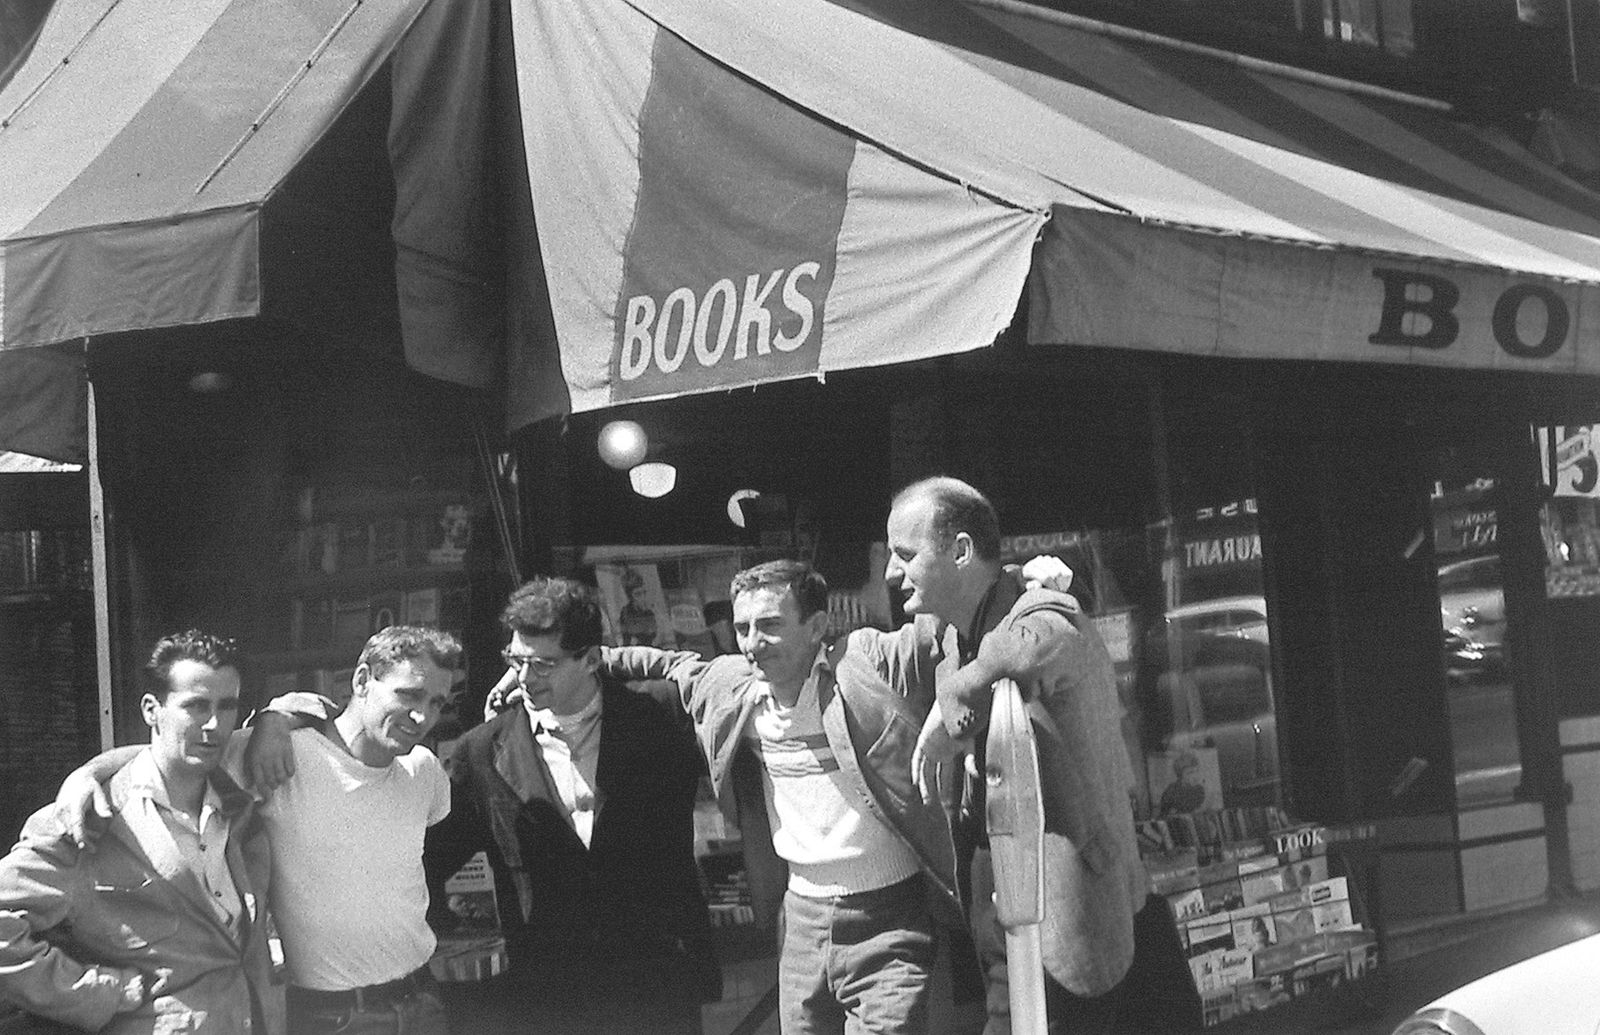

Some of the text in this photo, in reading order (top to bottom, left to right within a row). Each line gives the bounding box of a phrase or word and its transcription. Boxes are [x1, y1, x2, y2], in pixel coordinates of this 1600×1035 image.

[620, 261, 820, 380] BOOKS
[1368, 267, 1570, 359] BO
[1276, 829, 1326, 854] LOOK
